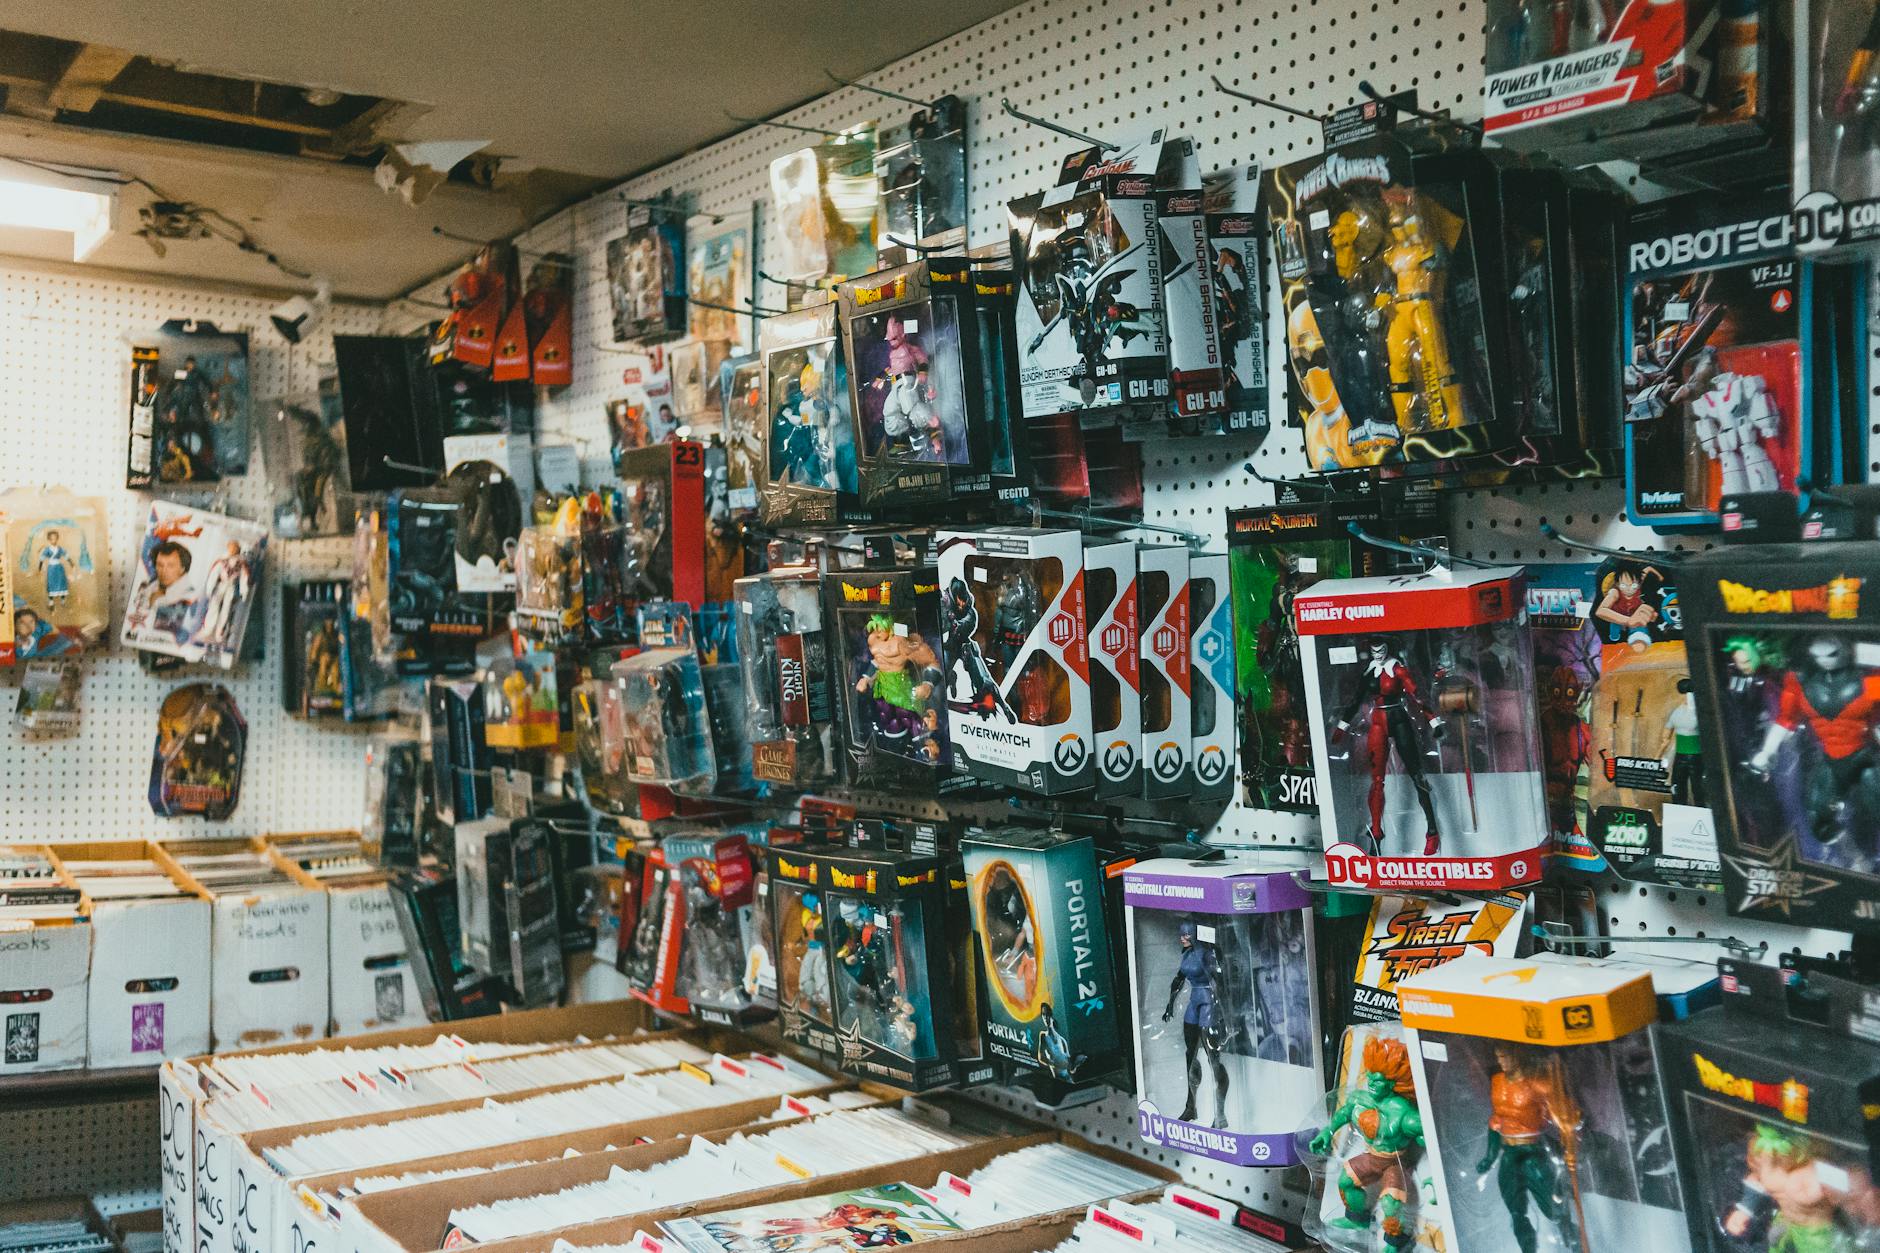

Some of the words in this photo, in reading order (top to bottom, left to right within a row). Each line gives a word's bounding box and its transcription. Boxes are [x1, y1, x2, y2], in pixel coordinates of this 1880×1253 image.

[1489, 70, 1539, 99] POWER
[1552, 49, 1621, 82] RANGERS
[1143, 203, 1156, 255] GUNDAM
[1796, 203, 1844, 245] DC
[1630, 214, 1796, 273] ROBOTECH
[1752, 263, 1793, 283] VF-1J
[1193, 219, 1206, 280] GUNDAM
[1200, 285, 1217, 364] BARBATOS
[1147, 259, 1165, 353] DEATHSCYTHE
[1244, 241, 1256, 278] UNICORN
[1252, 342, 1263, 386] BANSHEE
[1021, 371, 1043, 384] GUNDAM
[1096, 363, 1117, 377] GU-06
[1128, 379, 1169, 398] GU-06
[1186, 390, 1225, 411] GU-04
[1229, 410, 1267, 429] GU-05
[676, 446, 699, 465] 23
[898, 475, 924, 489] MAJIN
[998, 486, 1030, 500] VEGITO
[844, 511, 872, 521] VEGETA
[1236, 518, 1271, 533] MORTAL
[1279, 512, 1318, 530] KOMBAT
[842, 580, 868, 602] DRAGON
[1301, 607, 1343, 621] HARLEY
[1345, 604, 1384, 621] QUINN
[1527, 588, 1583, 616] STERS
[781, 658, 796, 702] KING
[794, 661, 803, 697] NIGHT
[961, 723, 1031, 748] OVERWATCH
[760, 745, 784, 763] GAME
[758, 761, 791, 781] THRONES
[1635, 759, 1659, 771] ACTION
[1605, 825, 1649, 846] ZORO
[1326, 855, 1372, 884] DC
[1377, 861, 1493, 880] COLLECTIBLES
[1513, 864, 1524, 876] 13
[1748, 867, 1806, 880] DRAGON
[1125, 882, 1163, 897] KNIGHTFALL
[1163, 885, 1204, 899] CATWOMAN
[1380, 879, 1398, 887] DIRECT
[1398, 879, 1412, 887] FROM
[1413, 879, 1423, 887] THE
[1424, 879, 1446, 887] SOURCE
[1747, 880, 1802, 897] STARS
[1065, 879, 1093, 980] PORTAL
[1370, 910, 1479, 951] STREET
[1078, 980, 1097, 1000] 2
[1354, 1004, 1369, 1013] ACTION
[987, 1021, 1019, 1043] PORTAL
[1020, 1033, 1029, 1045] 2
[990, 1043, 1012, 1058] CHELL
[867, 1062, 889, 1077] FUTURE
[969, 1069, 993, 1082] GOKU
[162, 1085, 185, 1161] DC
[1139, 1109, 1164, 1142] DC
[1166, 1122, 1238, 1154] COLLECTIBLES
[1255, 1146, 1268, 1156] 22
[198, 1129, 218, 1182] DC
[238, 1168, 257, 1234] DC
